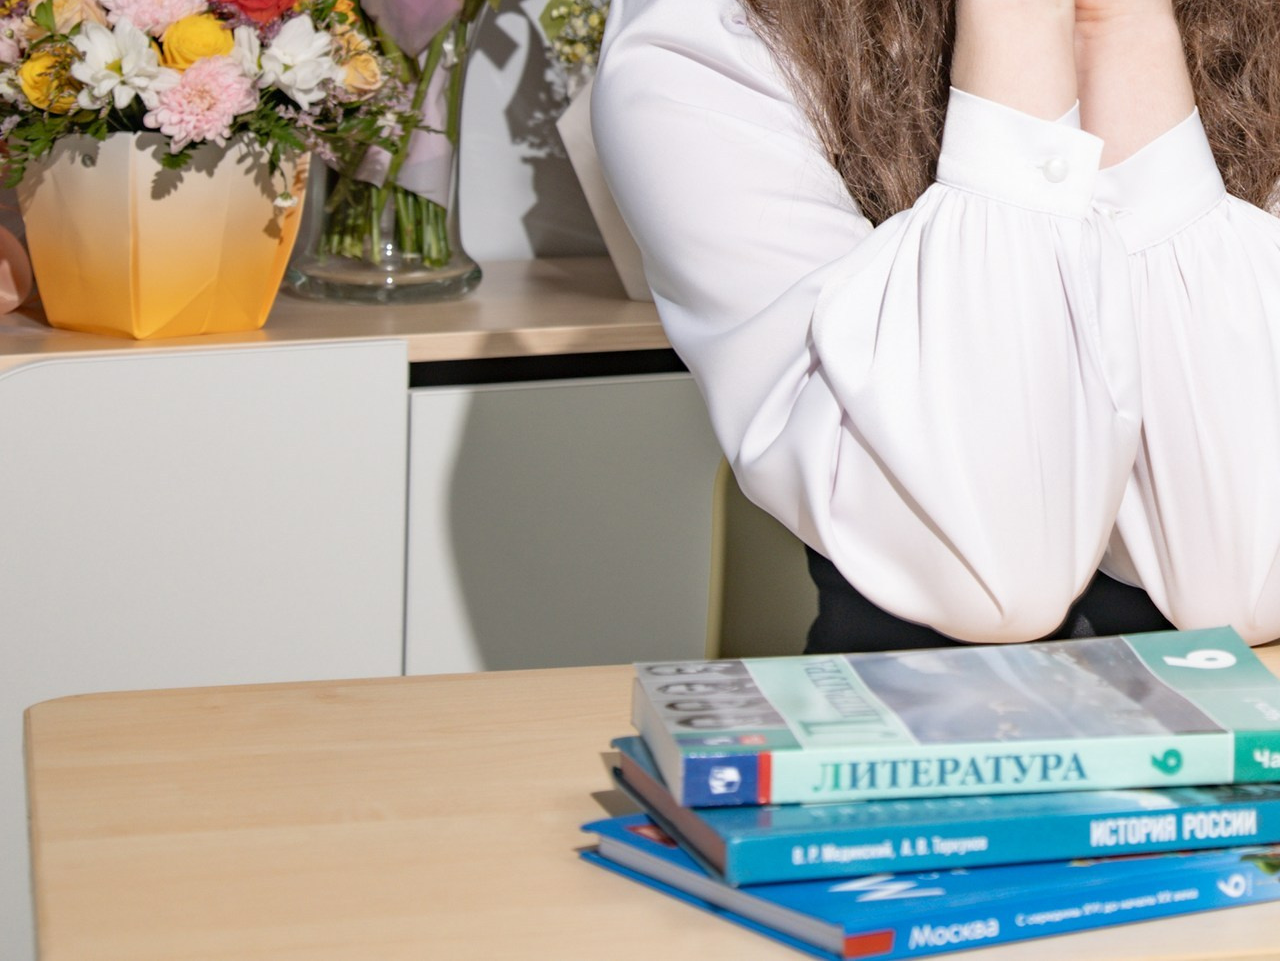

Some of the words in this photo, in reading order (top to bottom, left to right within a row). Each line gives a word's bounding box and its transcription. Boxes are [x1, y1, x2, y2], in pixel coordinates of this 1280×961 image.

[1162, 649, 1237, 670] 6
[812, 753, 1088, 793] ЛИТЕРАТУРА
[1150, 748, 1184, 776] 6
[1090, 814, 1177, 847] ИСТОРИЯ
[1182, 809, 1257, 840] РОССИИ
[908, 918, 1000, 950] Москва
[1216, 873, 1247, 898] 6
